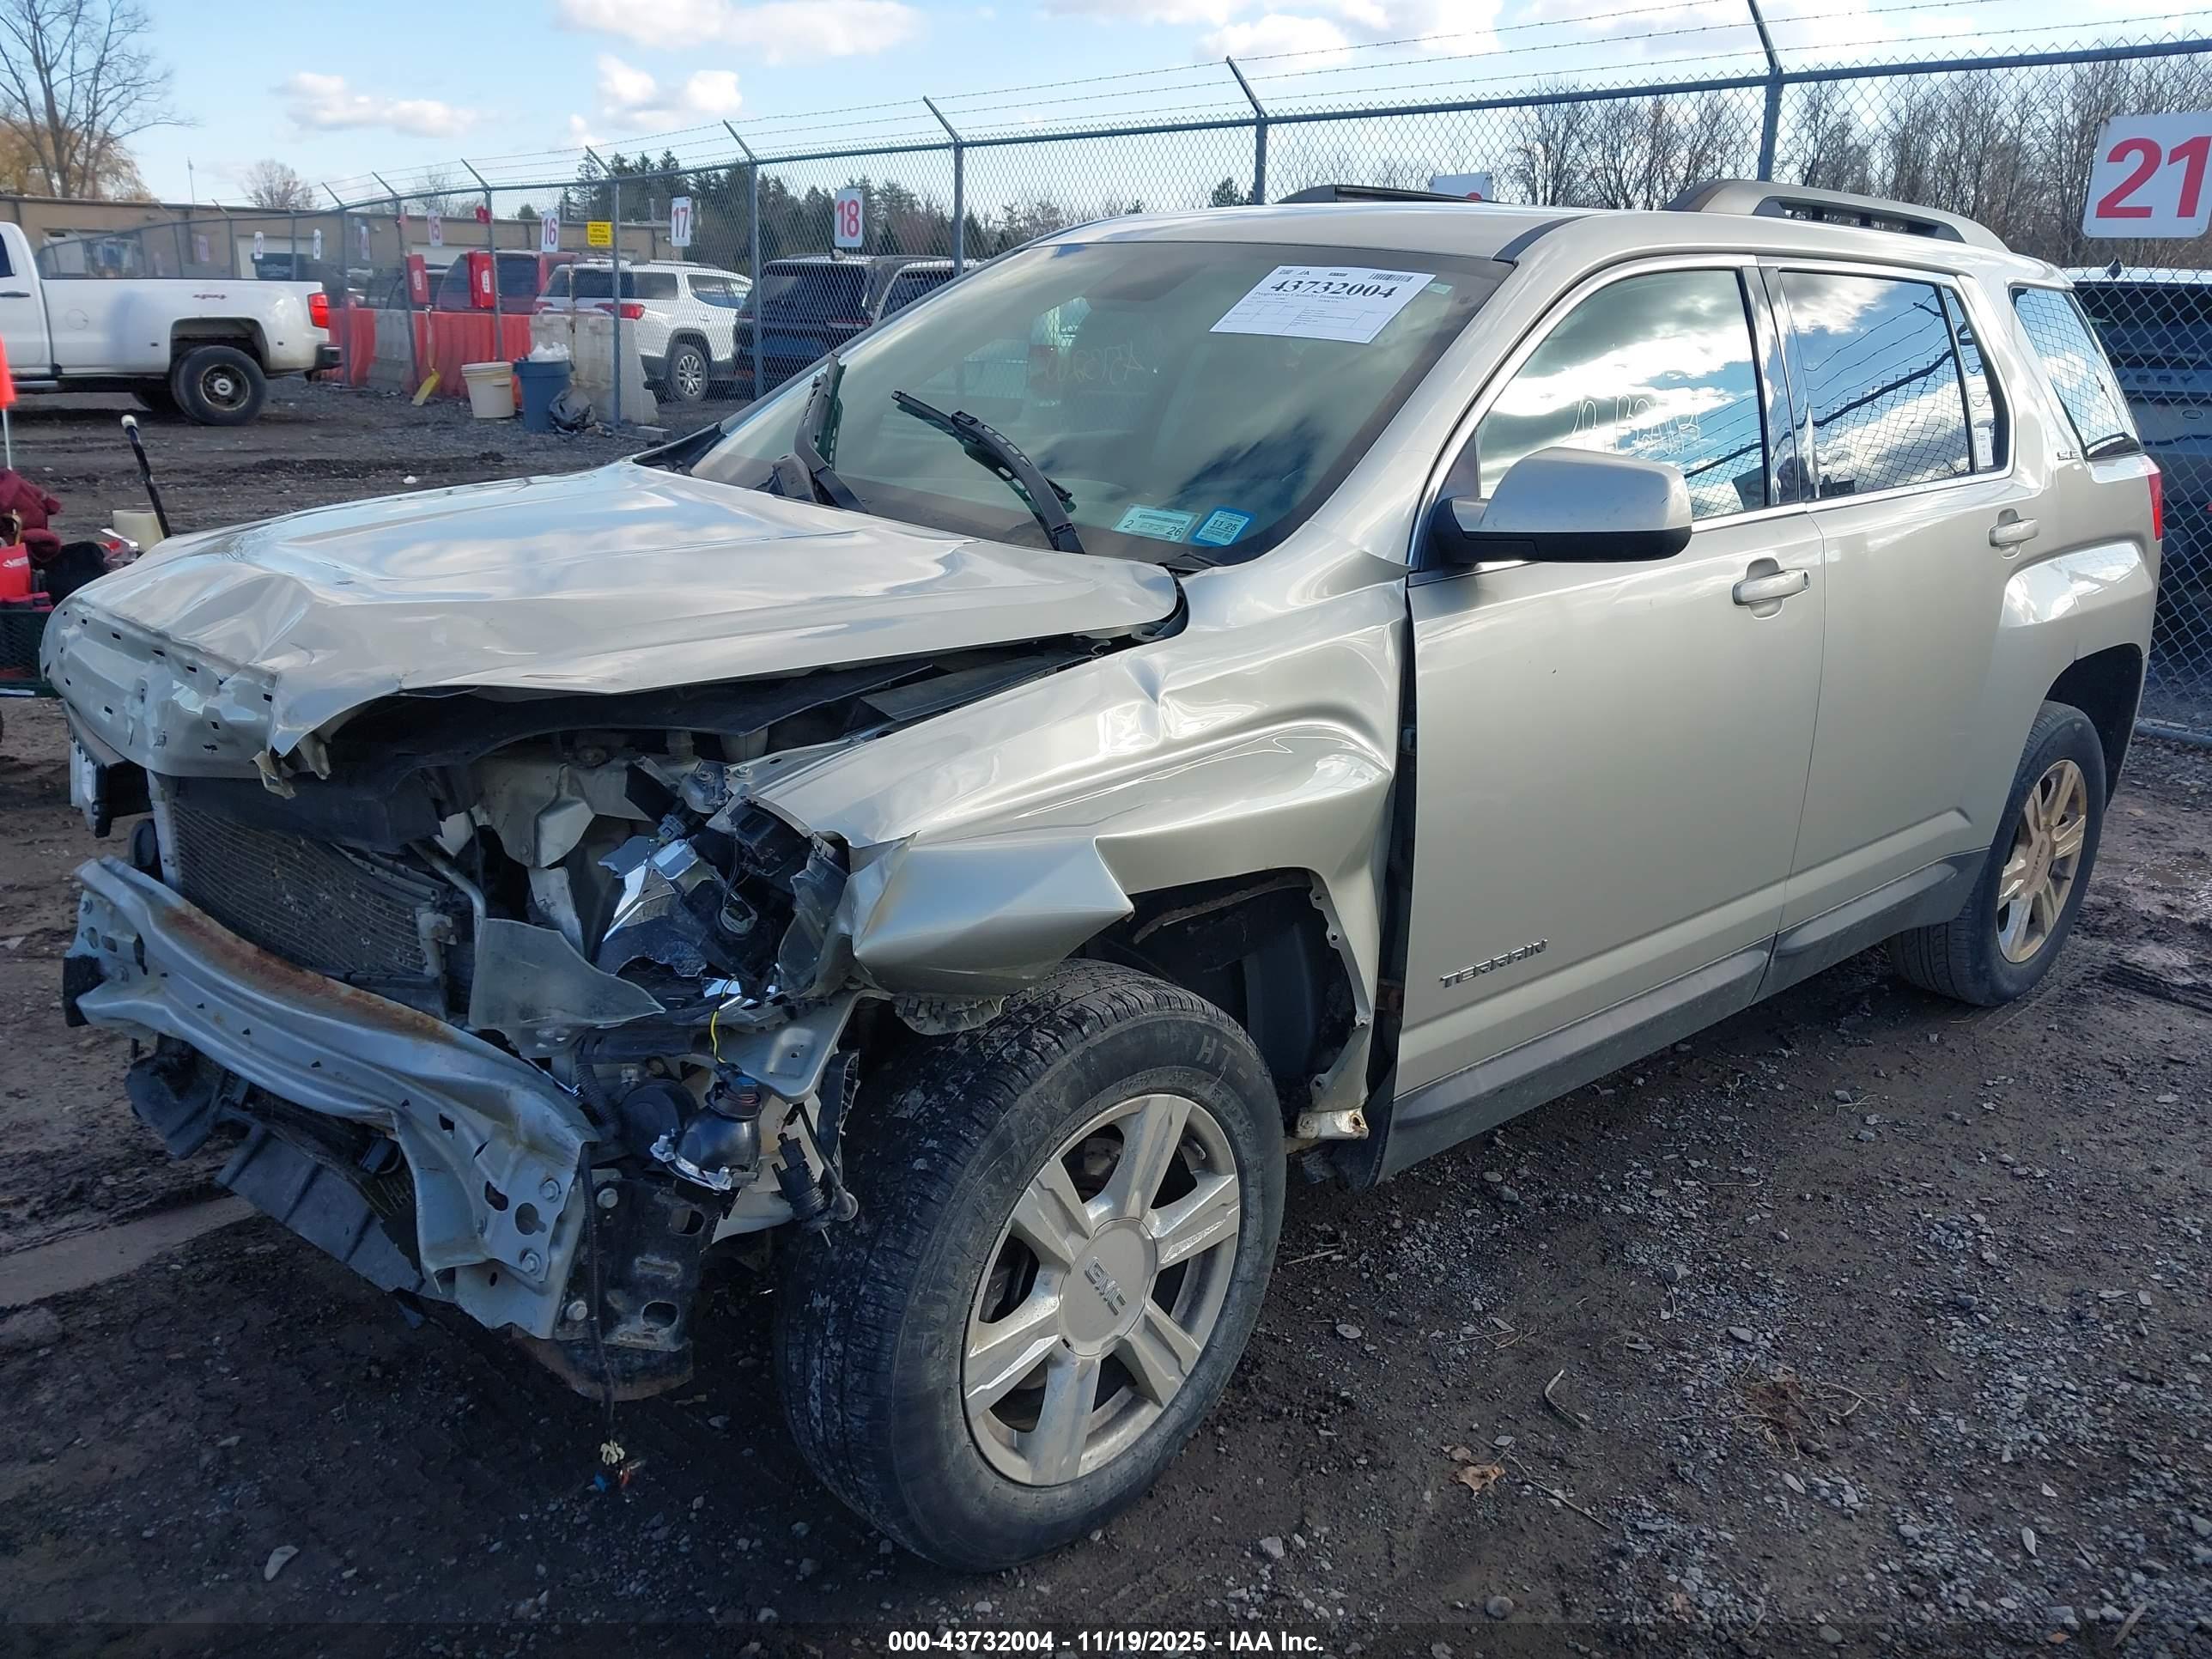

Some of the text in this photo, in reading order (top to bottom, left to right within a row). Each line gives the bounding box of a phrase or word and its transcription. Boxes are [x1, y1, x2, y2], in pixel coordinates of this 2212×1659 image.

[2095, 136, 2212, 218] 21
[543, 217, 557, 246] 16
[672, 207, 689, 238] 17
[837, 199, 860, 238] 18
[1271, 279, 1398, 299] 43732004
[1123, 519, 1134, 529] 2
[1166, 526, 1184, 537] 26
[1439, 939, 1548, 988] TERRAIN
[1084, 1255, 1127, 1316] GMC
